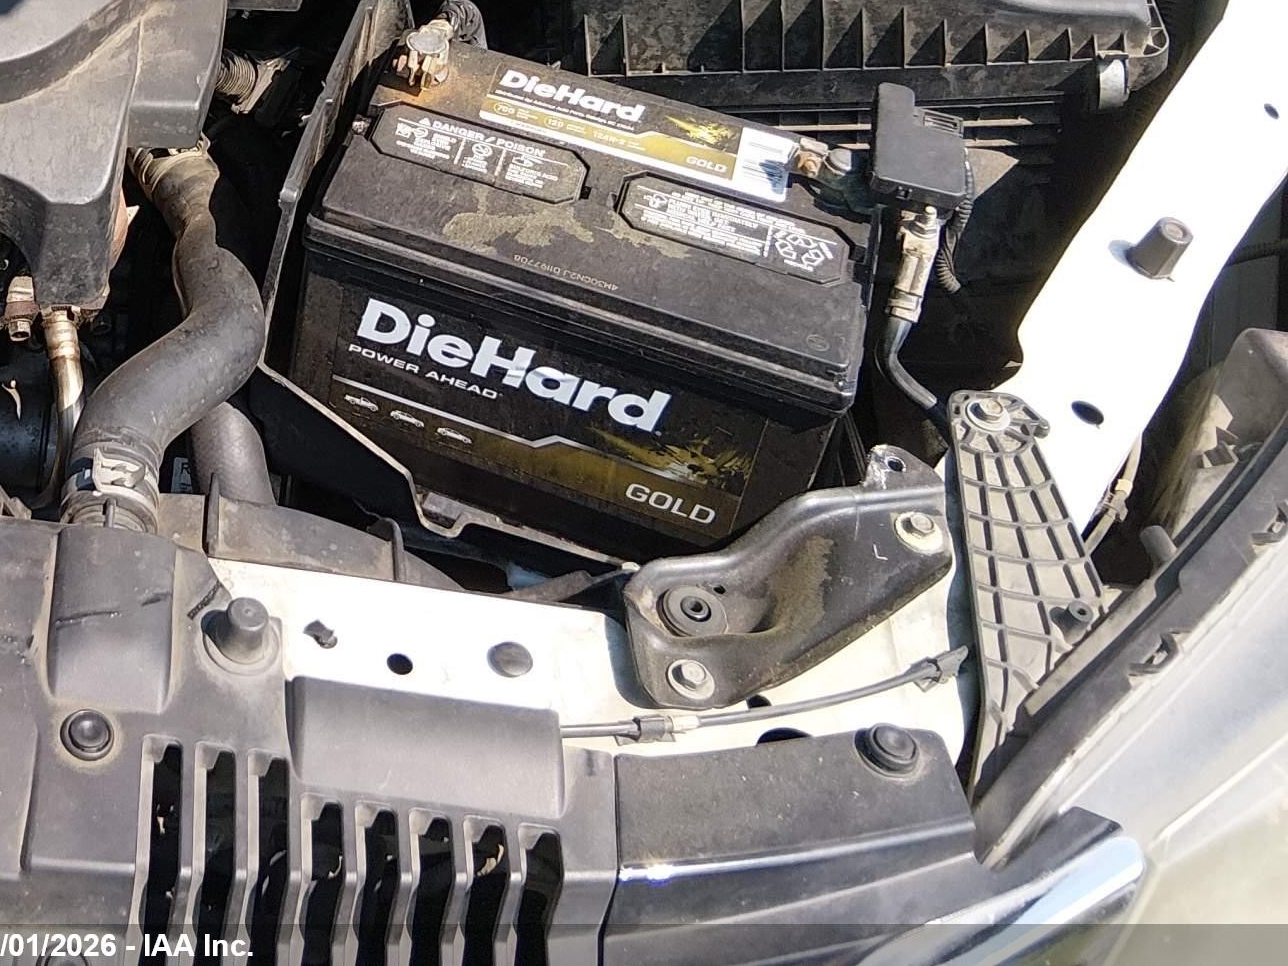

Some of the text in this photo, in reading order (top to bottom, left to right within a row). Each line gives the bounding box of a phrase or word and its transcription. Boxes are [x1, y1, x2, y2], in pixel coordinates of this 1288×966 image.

[499, 70, 646, 122] DieHard
[432, 120, 486, 141] DANGER
[496, 137, 544, 157] POISON
[686, 156, 728, 173] GOLD
[348, 344, 497, 399] POWER AHEAD
[357, 298, 672, 432] DieHard
[624, 482, 715, 524] GOLD
